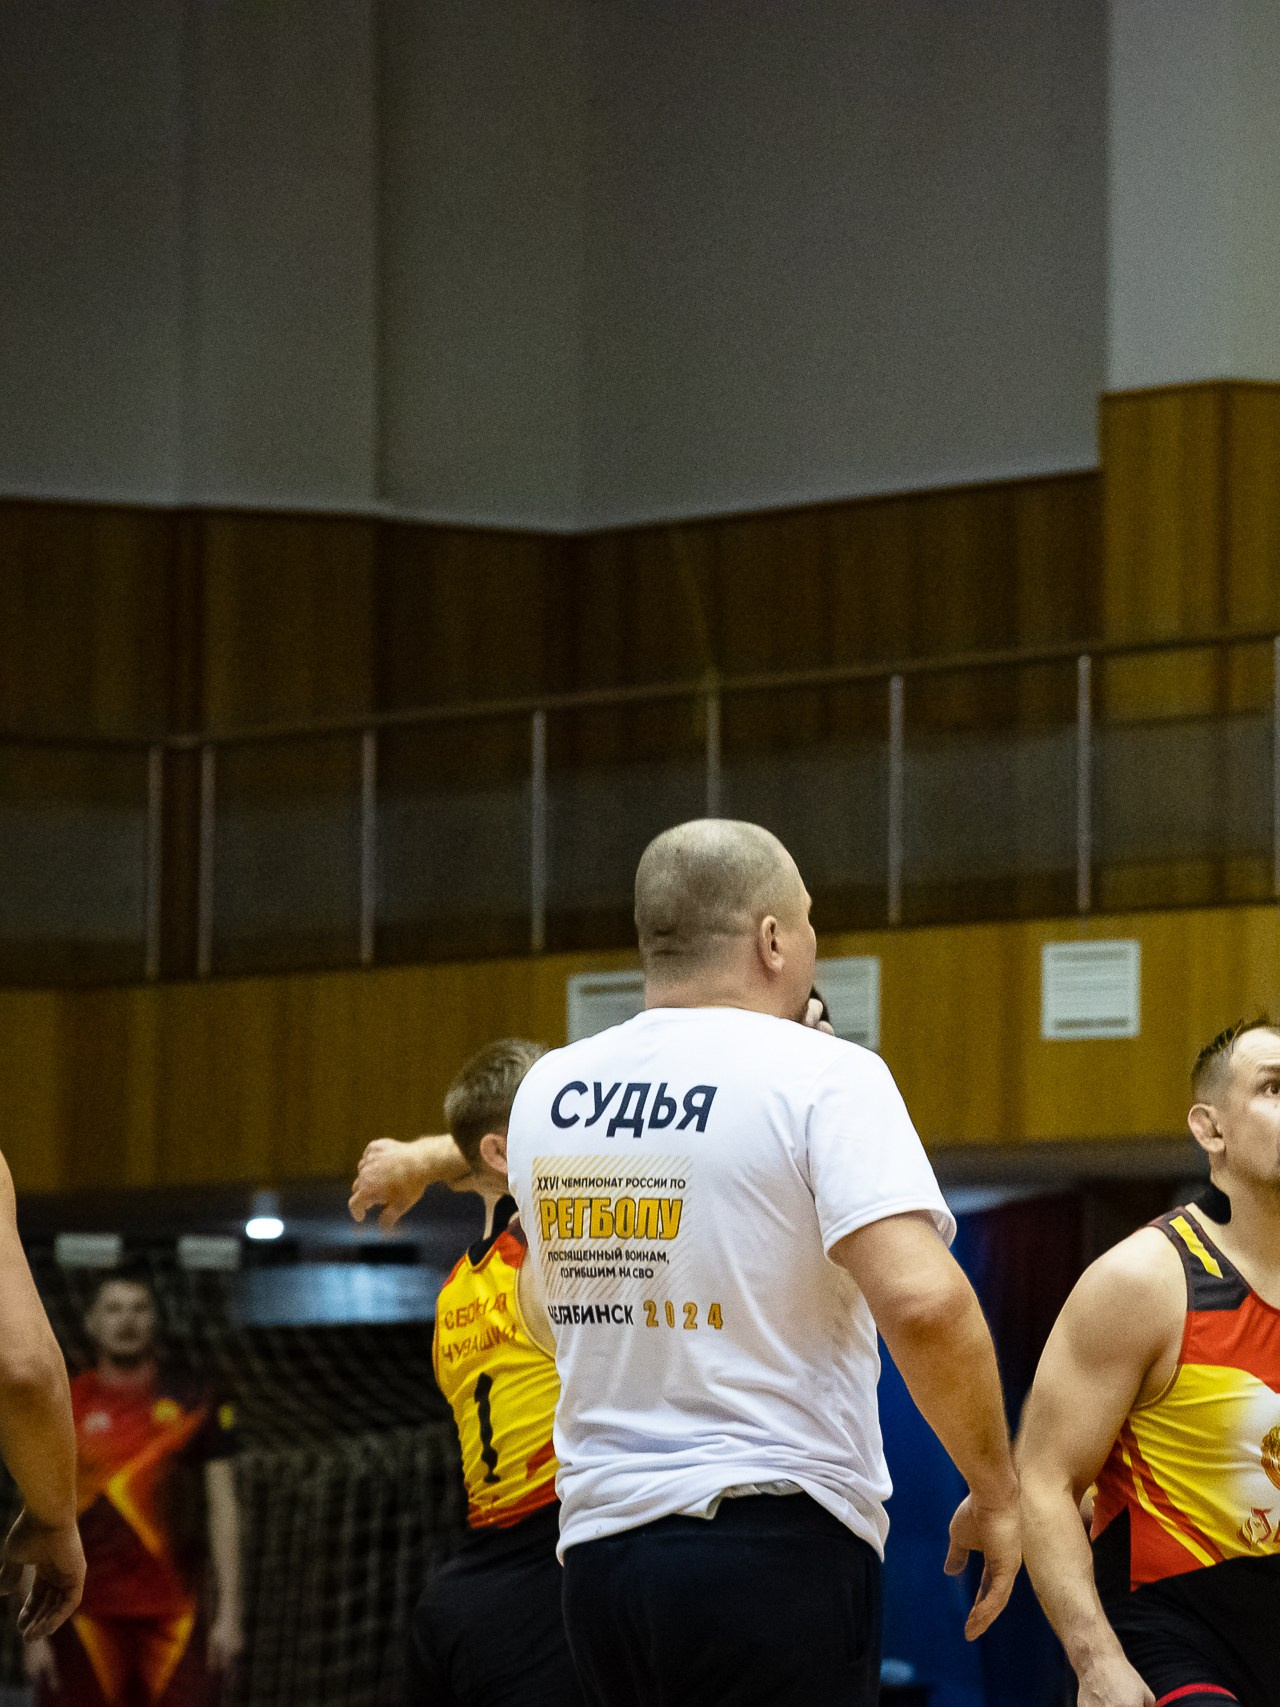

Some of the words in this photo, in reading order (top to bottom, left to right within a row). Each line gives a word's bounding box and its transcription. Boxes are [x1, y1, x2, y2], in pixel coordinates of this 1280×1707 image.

[550, 1080, 718, 1138] СУДЬЯ
[537, 1176, 559, 1191] XXVI
[561, 1177, 622, 1188] ЧЕМПИОНАТ
[625, 1178, 667, 1189] РОССИИ
[670, 1178, 686, 1190] ПО
[538, 1197, 684, 1241] РЕГБОЛУ
[625, 1250, 670, 1265] ВОИНАМ,
[619, 1267, 631, 1278] НА
[632, 1268, 654, 1279] СВО
[643, 1300, 724, 1330] 2024
[474, 1372, 501, 1484] 1
